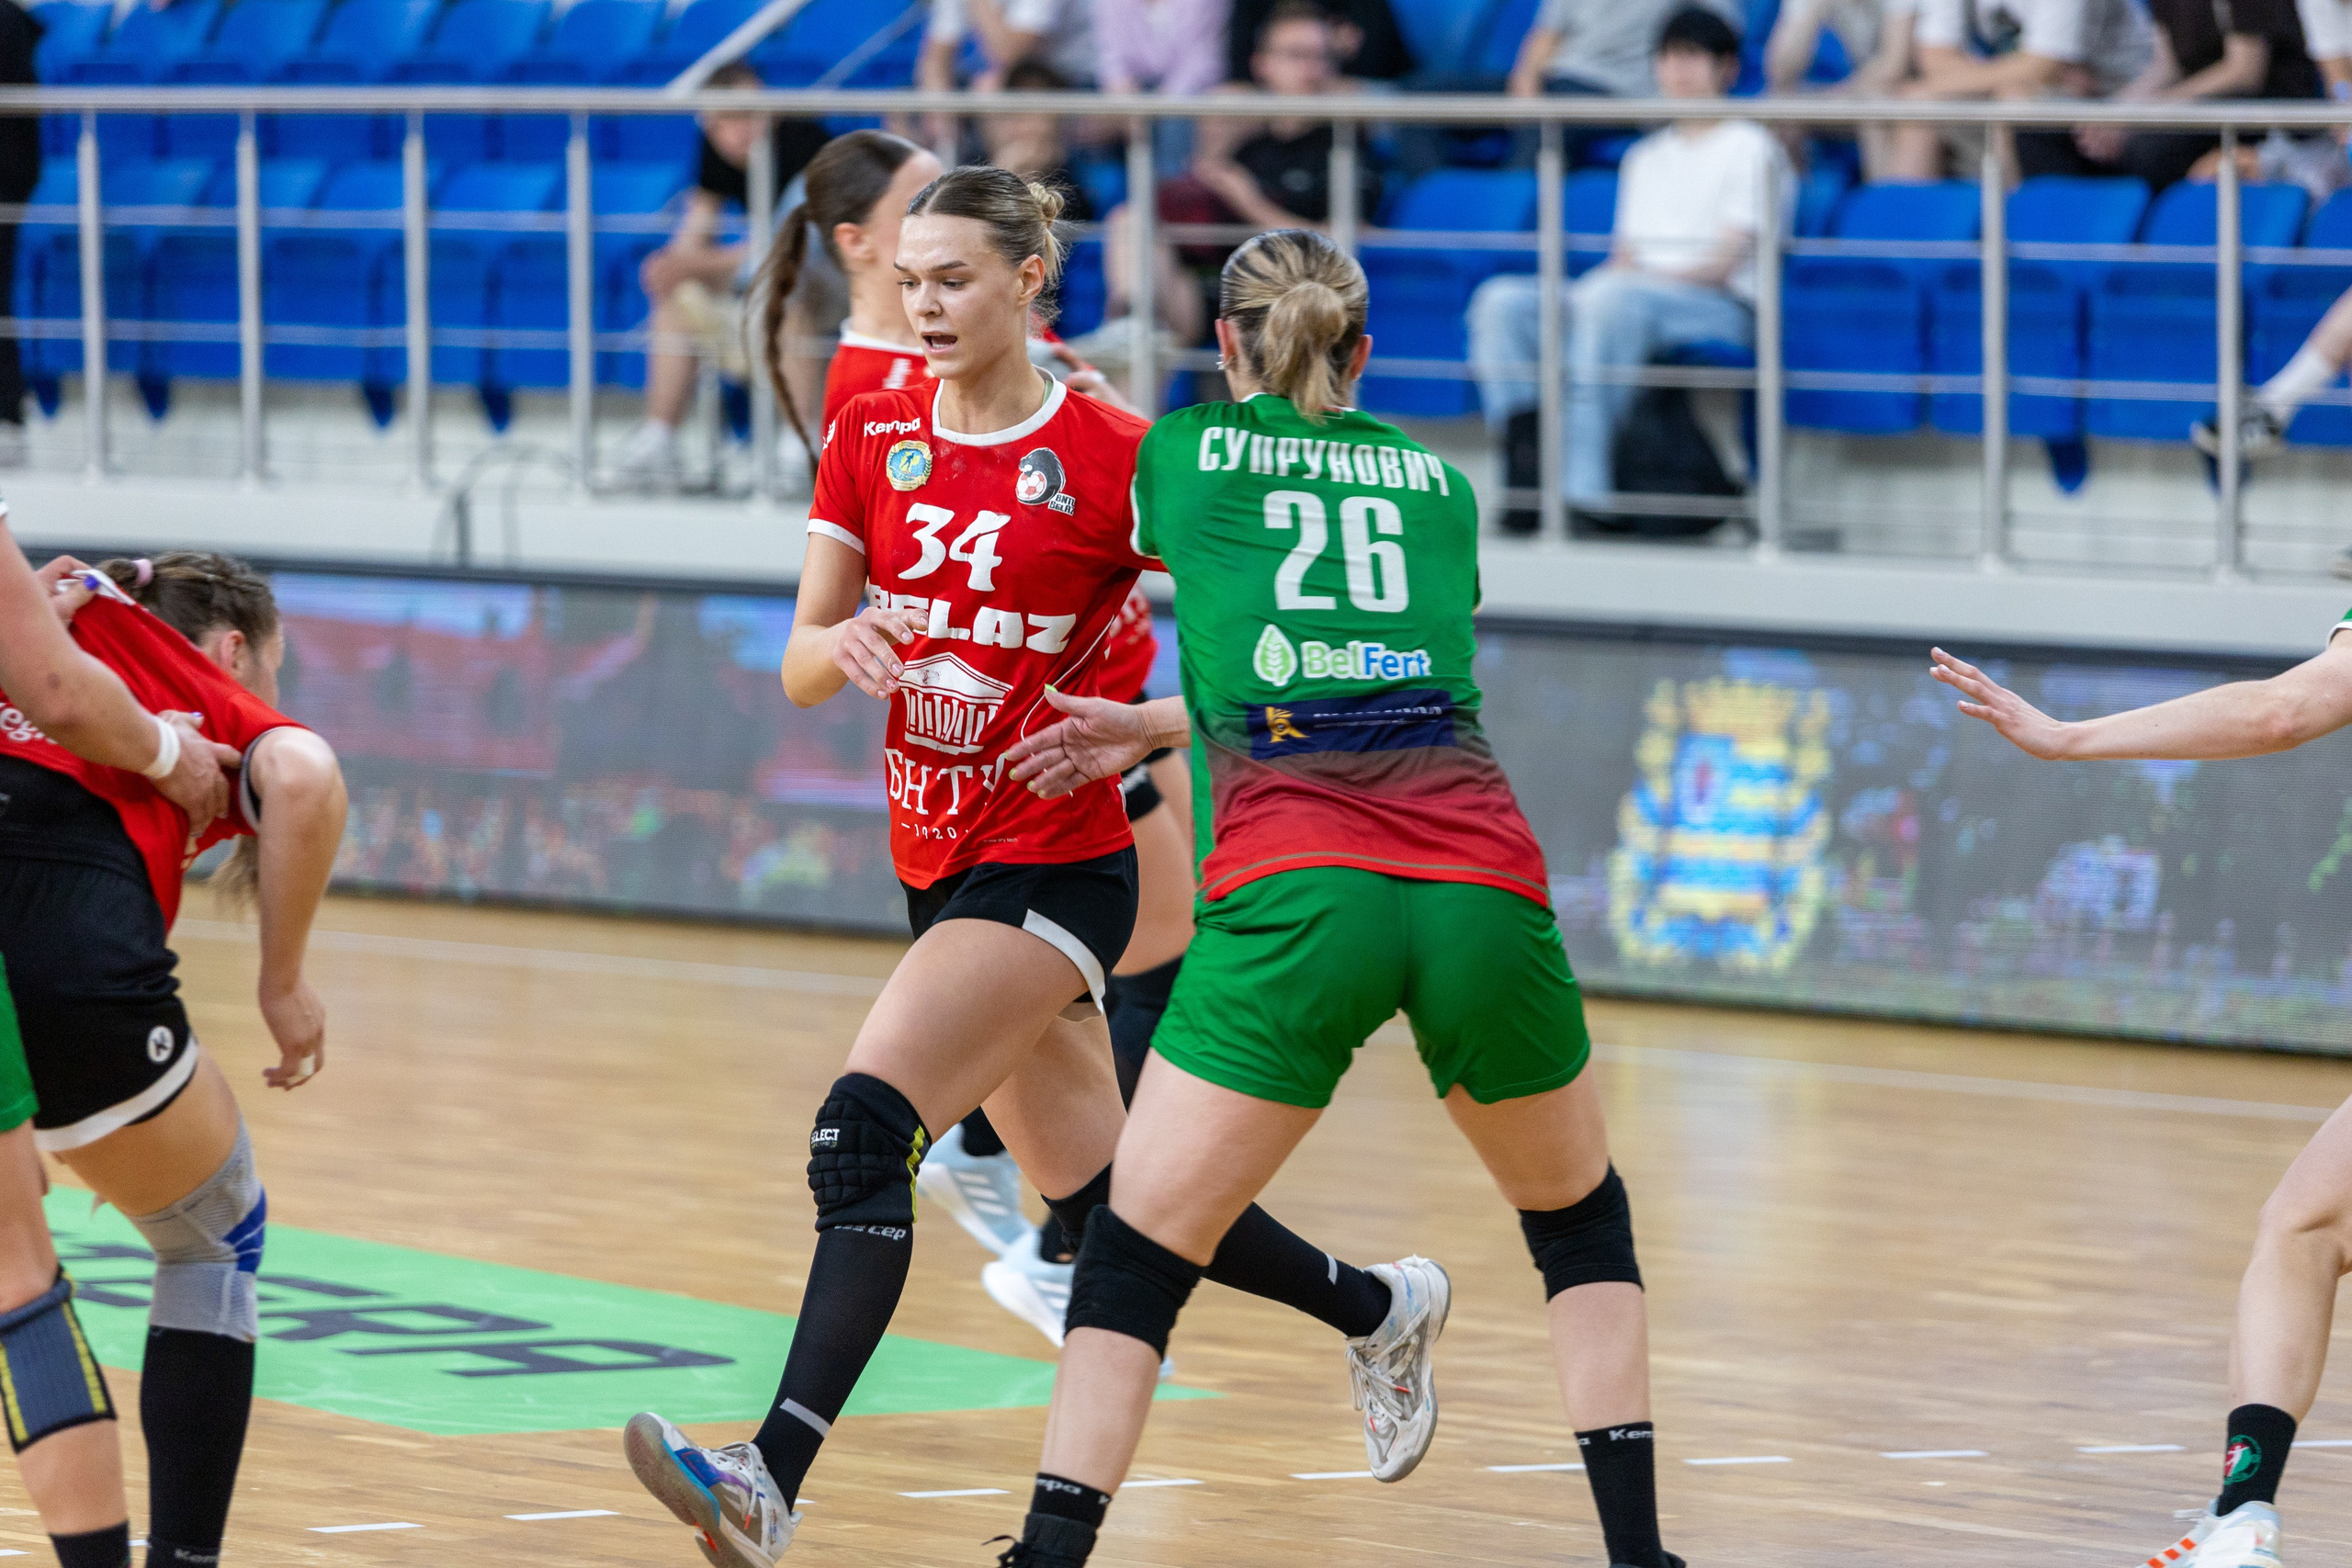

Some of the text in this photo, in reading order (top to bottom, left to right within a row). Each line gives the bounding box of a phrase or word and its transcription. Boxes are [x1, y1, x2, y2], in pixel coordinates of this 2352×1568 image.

[865, 417, 921, 437] Kempa
[1198, 426, 1450, 497] СУПРУНОВИЧ
[898, 502, 1011, 592] 34
[1263, 490, 1409, 614] 26
[1303, 642, 1429, 678] BelFert
